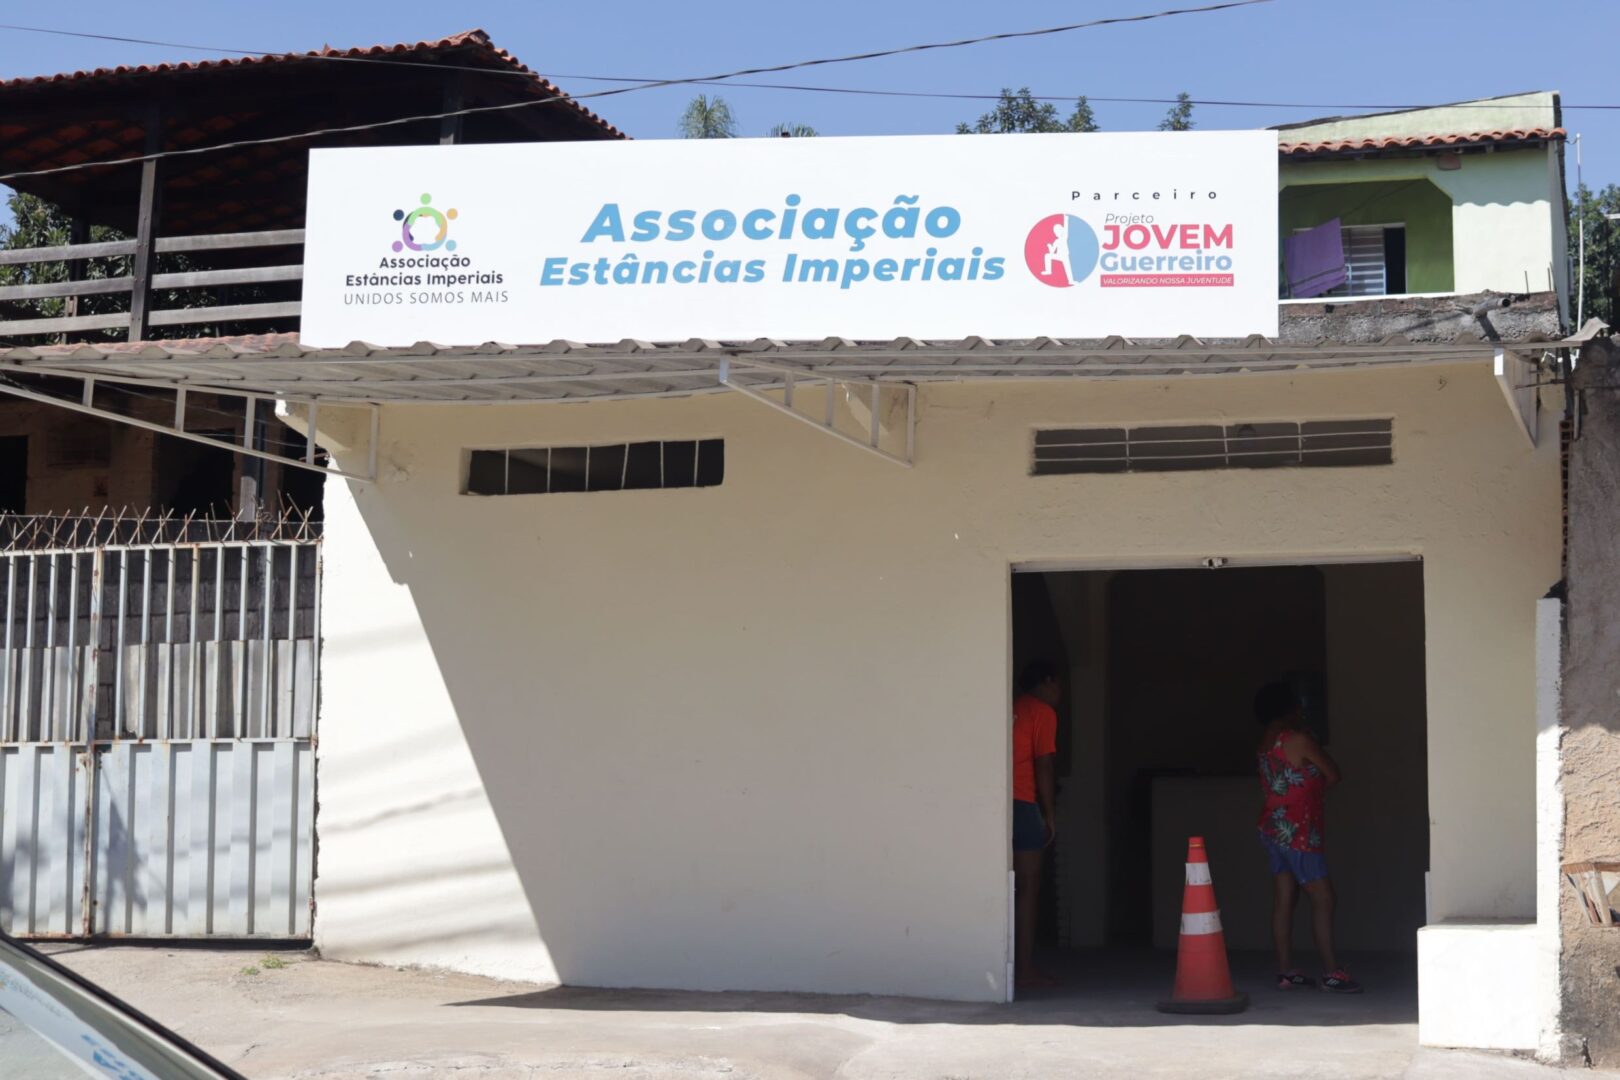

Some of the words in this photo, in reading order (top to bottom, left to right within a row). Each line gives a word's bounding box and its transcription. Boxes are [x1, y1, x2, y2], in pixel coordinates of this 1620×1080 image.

[1071, 189, 1217, 201] Parceiro
[580, 194, 961, 253] Associação
[1105, 212, 1154, 226] Projeto
[1102, 224, 1233, 250] JOVEM
[379, 254, 471, 271] Associação
[540, 250, 766, 287] Estâncias
[782, 247, 1006, 290] Imperiais
[1100, 249, 1232, 271] Guerreiro
[346, 272, 422, 287] Estâncias
[426, 270, 504, 288] Imperiais
[1103, 277, 1159, 285] VALORIZANDO
[1186, 276, 1232, 284] JUVENTUDE
[344, 293, 403, 305] UNIDOS
[409, 292, 464, 304] SOMOS
[471, 291, 509, 303] MAIS
